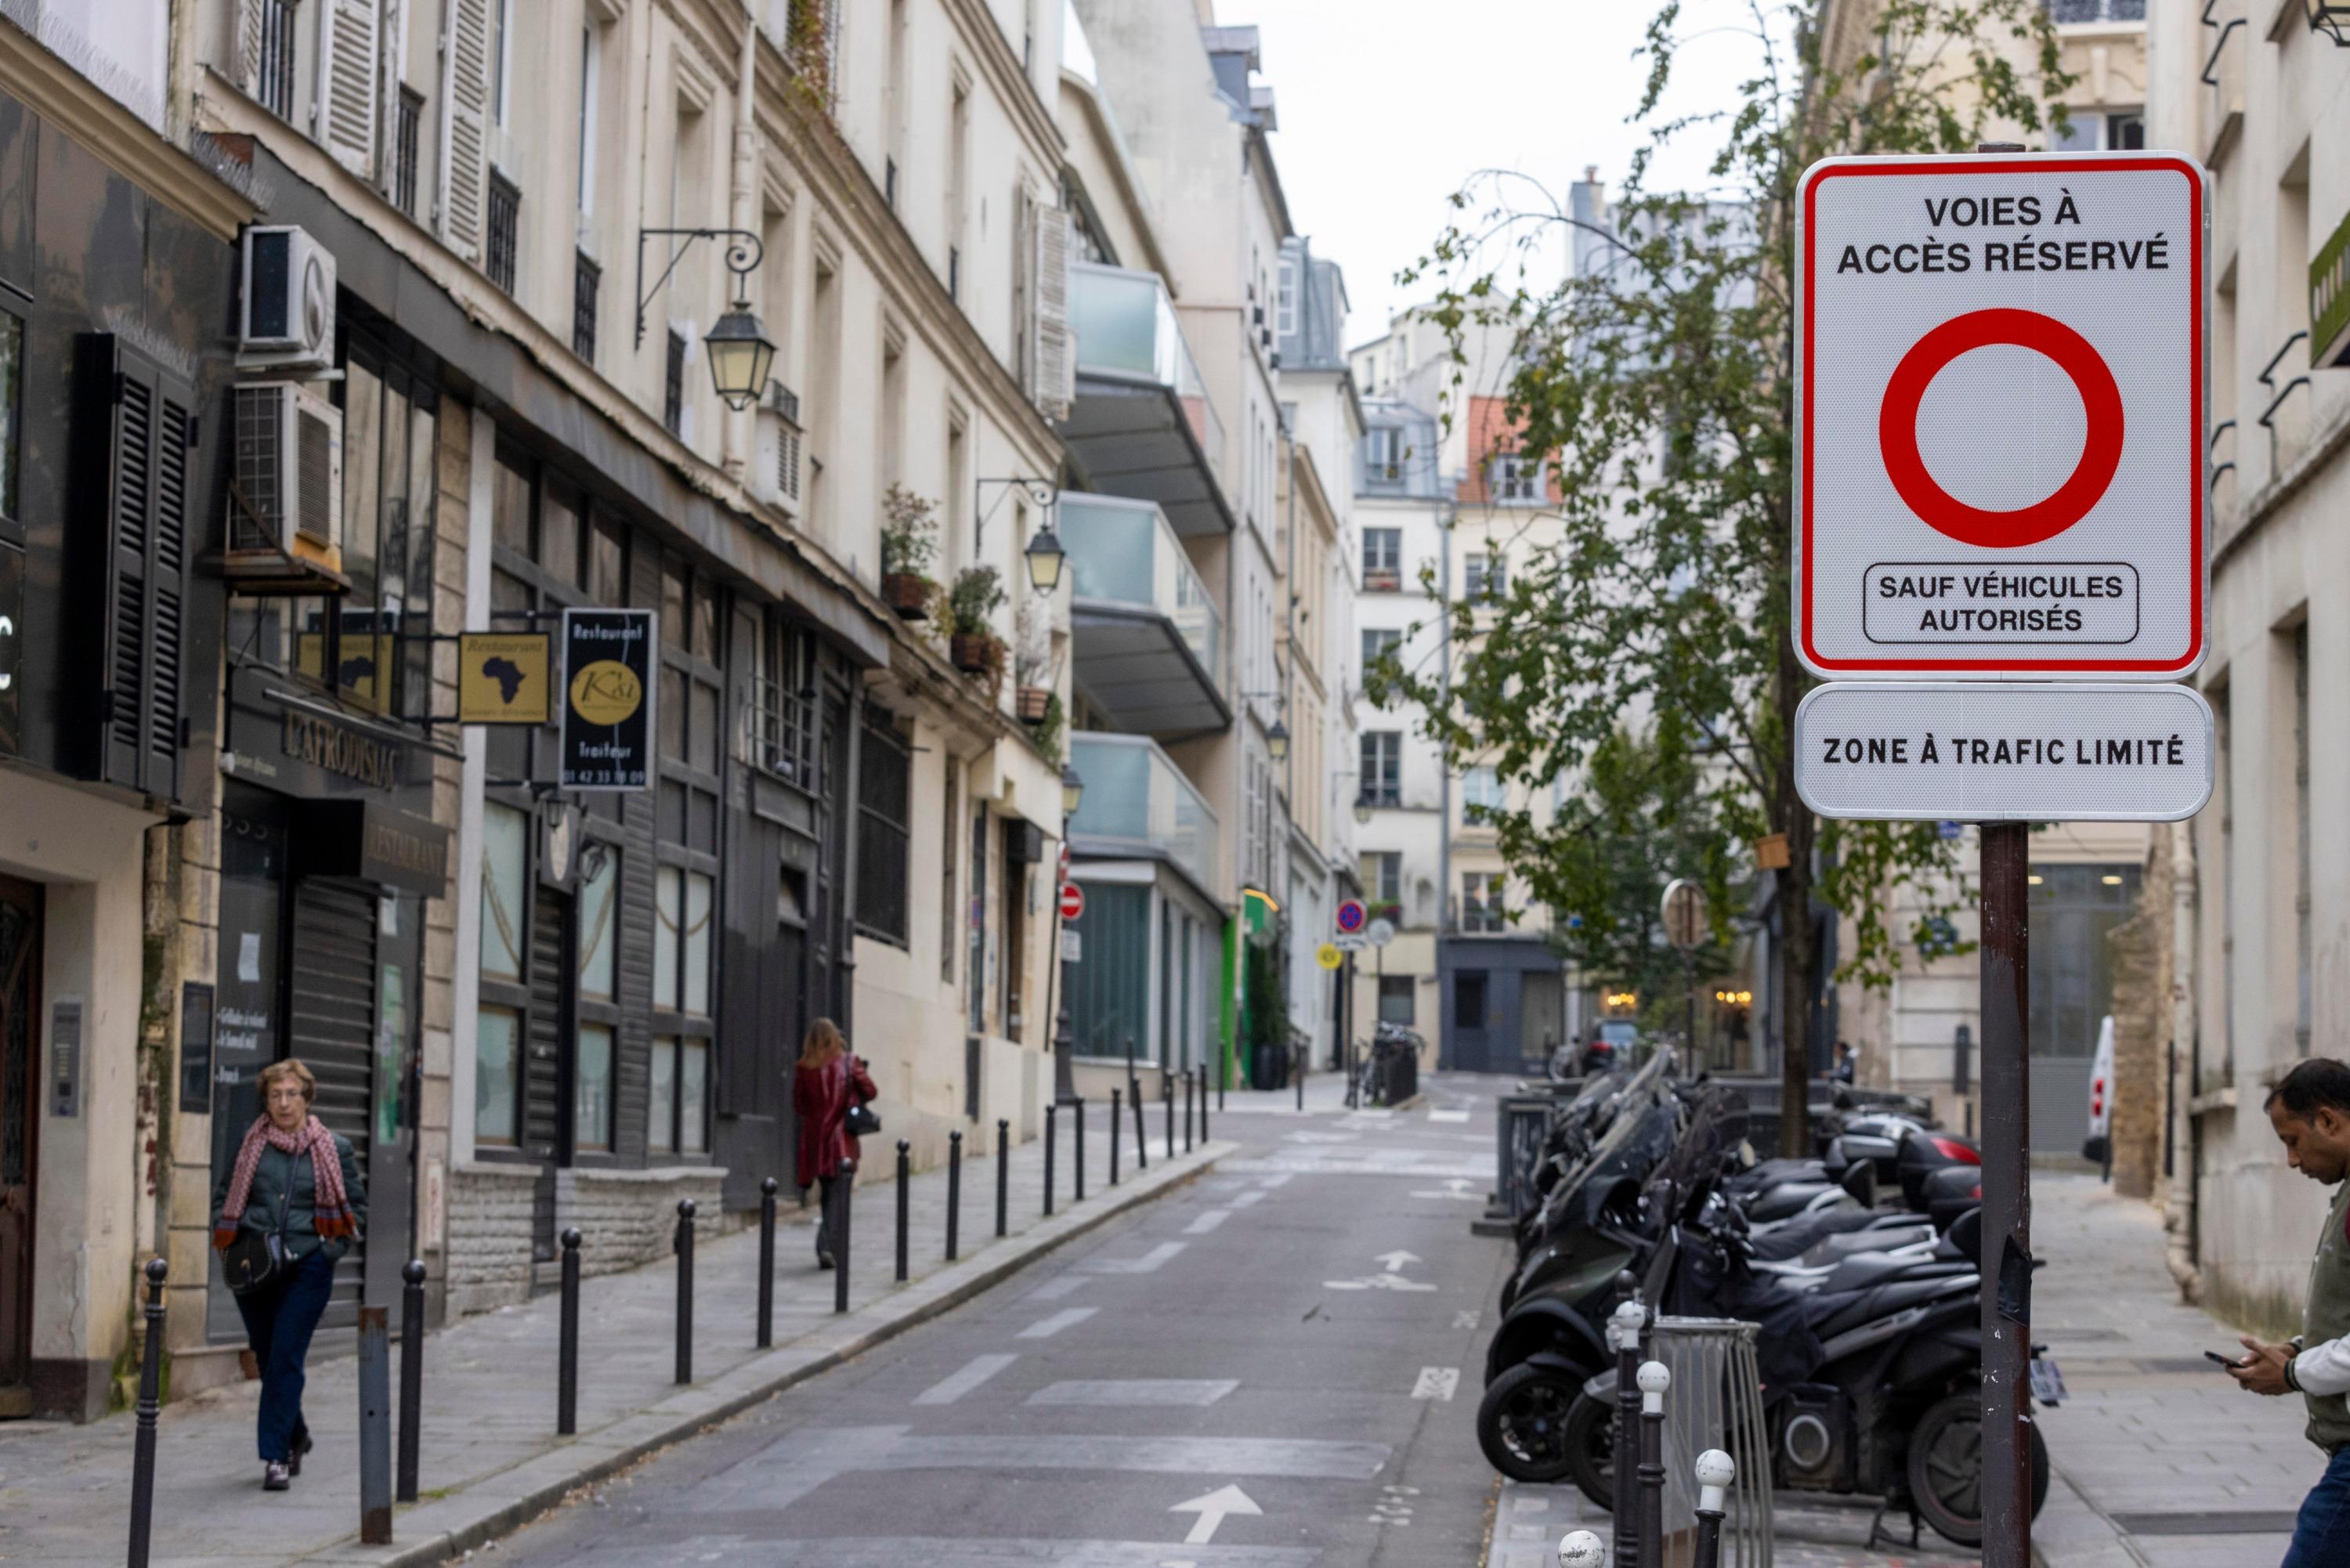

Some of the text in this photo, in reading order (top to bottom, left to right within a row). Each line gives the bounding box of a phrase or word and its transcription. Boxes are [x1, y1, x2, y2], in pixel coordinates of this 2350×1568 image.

[1924, 187, 2081, 227] VOIES À
[1837, 232, 2169, 274] ACCÈS RÉSERVÉ
[1879, 571, 2123, 598] SAUF VÉHICULES
[1919, 604, 2082, 631] AUTORISÉS
[573, 624, 642, 639] Restaurant
[579, 741, 631, 758] Traiteur
[1824, 732, 2184, 765] ZONE À TRAFIC LIMITÉ
[579, 769, 593, 783] 42
[596, 769, 610, 783] 33
